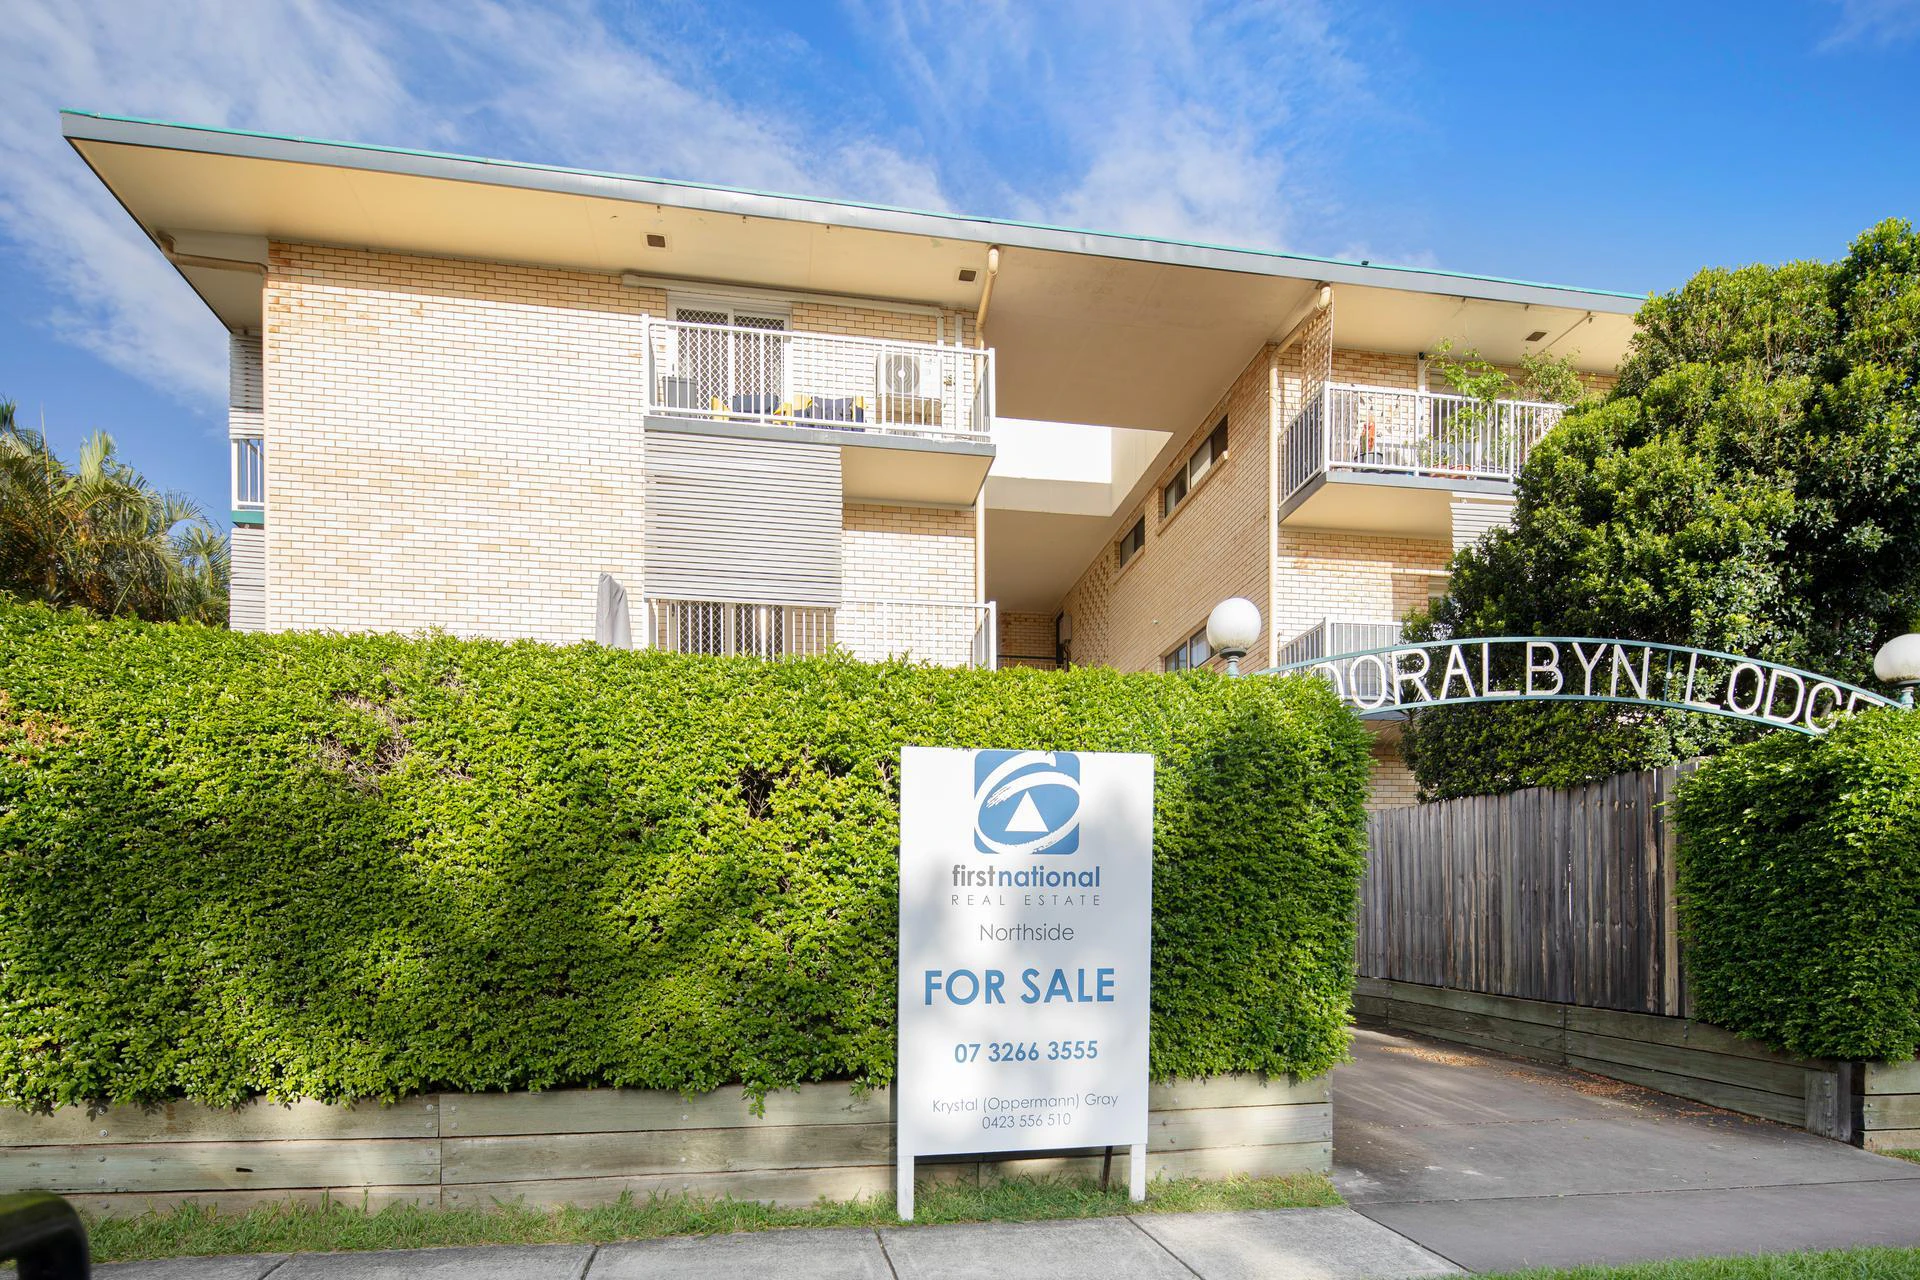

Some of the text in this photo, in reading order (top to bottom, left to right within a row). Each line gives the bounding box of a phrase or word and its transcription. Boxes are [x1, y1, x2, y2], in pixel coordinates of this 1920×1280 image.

[1270, 641, 1650, 711] ORALBYN
[951, 894, 1101, 906] REAL ESTATE
[979, 922, 1075, 942] Northside
[924, 967, 1115, 1006] FOR SALE
[954, 1039, 1099, 1064] 07 3266 3555
[931, 1093, 1119, 1114] Krystal (Oppermann) Gray
[981, 1112, 1072, 1130] 0423 556 510
